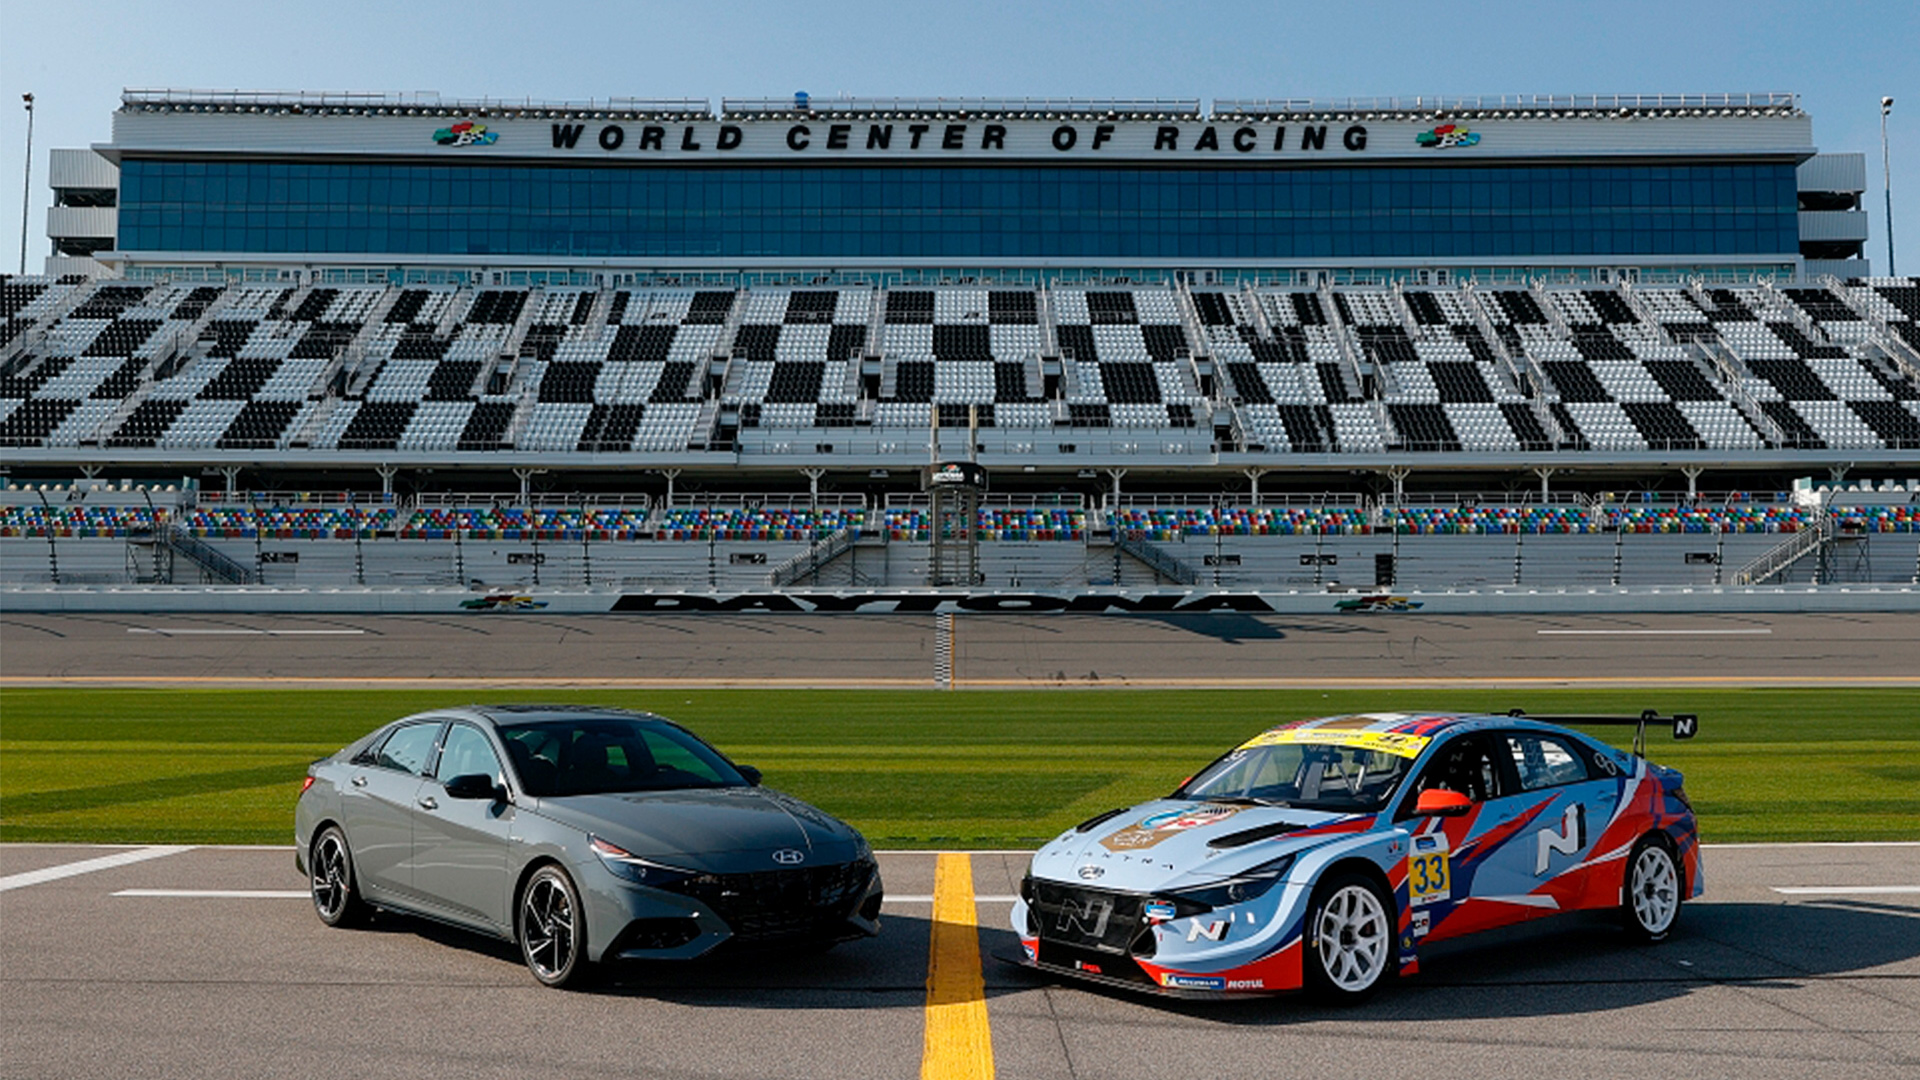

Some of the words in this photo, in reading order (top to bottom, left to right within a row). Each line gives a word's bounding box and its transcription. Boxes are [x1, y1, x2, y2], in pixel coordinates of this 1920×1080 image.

[551, 124, 743, 151] WORLD
[786, 124, 1007, 151] CENTER
[1052, 125, 1116, 151] OF
[1154, 125, 1368, 152] RACING
[609, 594, 1276, 612] DAYTONA
[1676, 718, 1694, 735] N
[1533, 801, 1586, 878] N
[1414, 855, 1446, 893] 33
[1186, 917, 1231, 942] N
[1227, 979, 1264, 988] MOTUL
